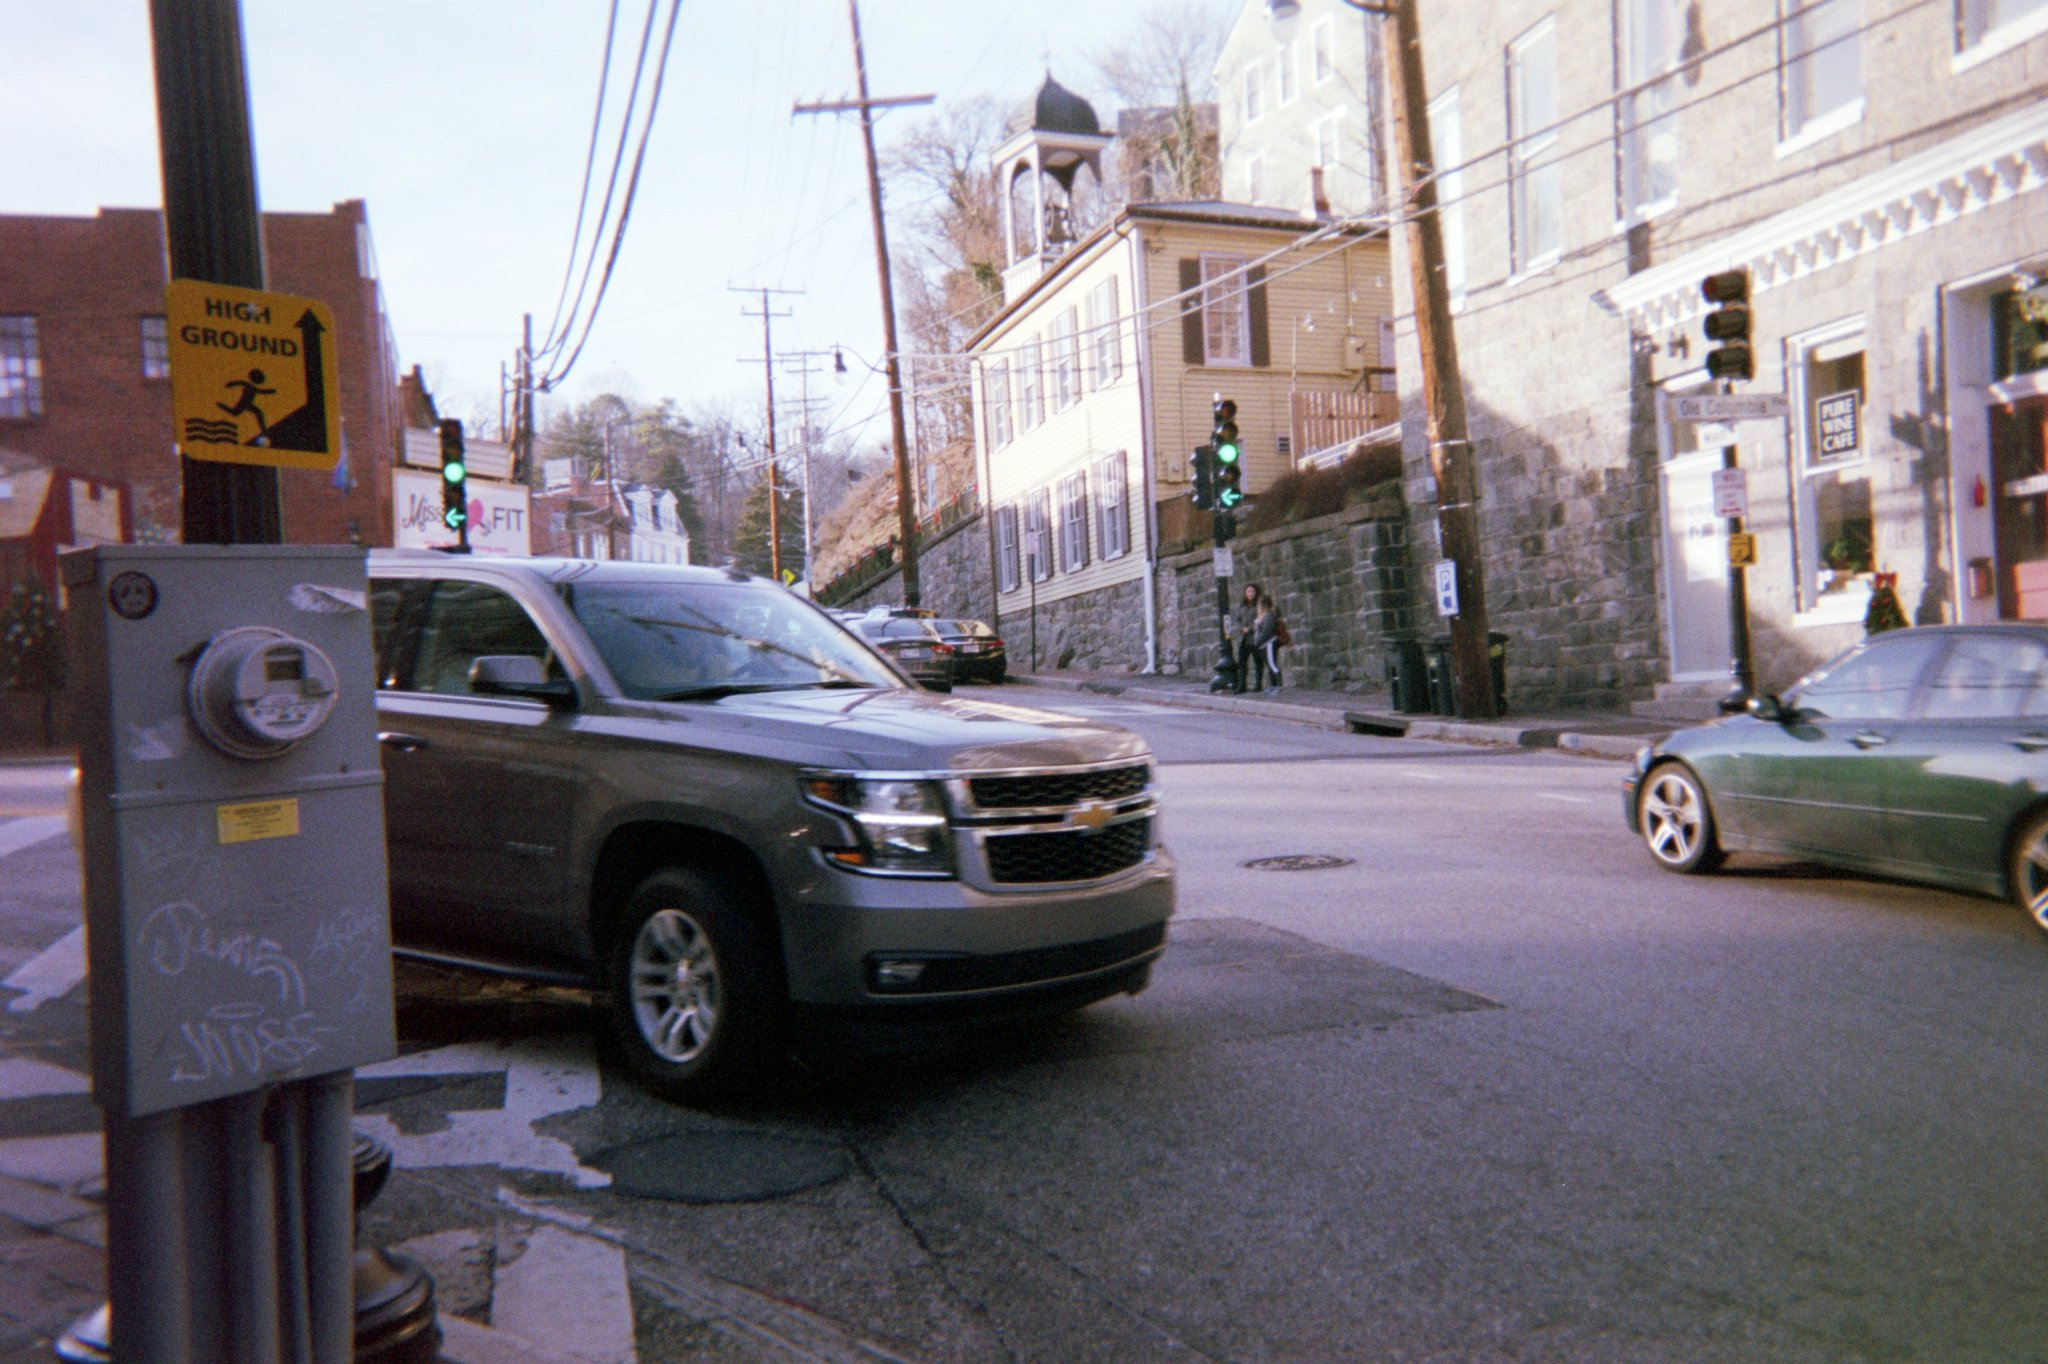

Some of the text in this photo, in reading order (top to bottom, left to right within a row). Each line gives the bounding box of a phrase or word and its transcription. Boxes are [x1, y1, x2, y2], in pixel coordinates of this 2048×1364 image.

[205, 298, 271, 324] HIGH
[181, 325, 298, 357] GROUND
[1821, 397, 1854, 419] PURE
[1822, 414, 1854, 434] WINE
[1823, 431, 1855, 451] CAFE
[492, 506, 525, 532] FIT
